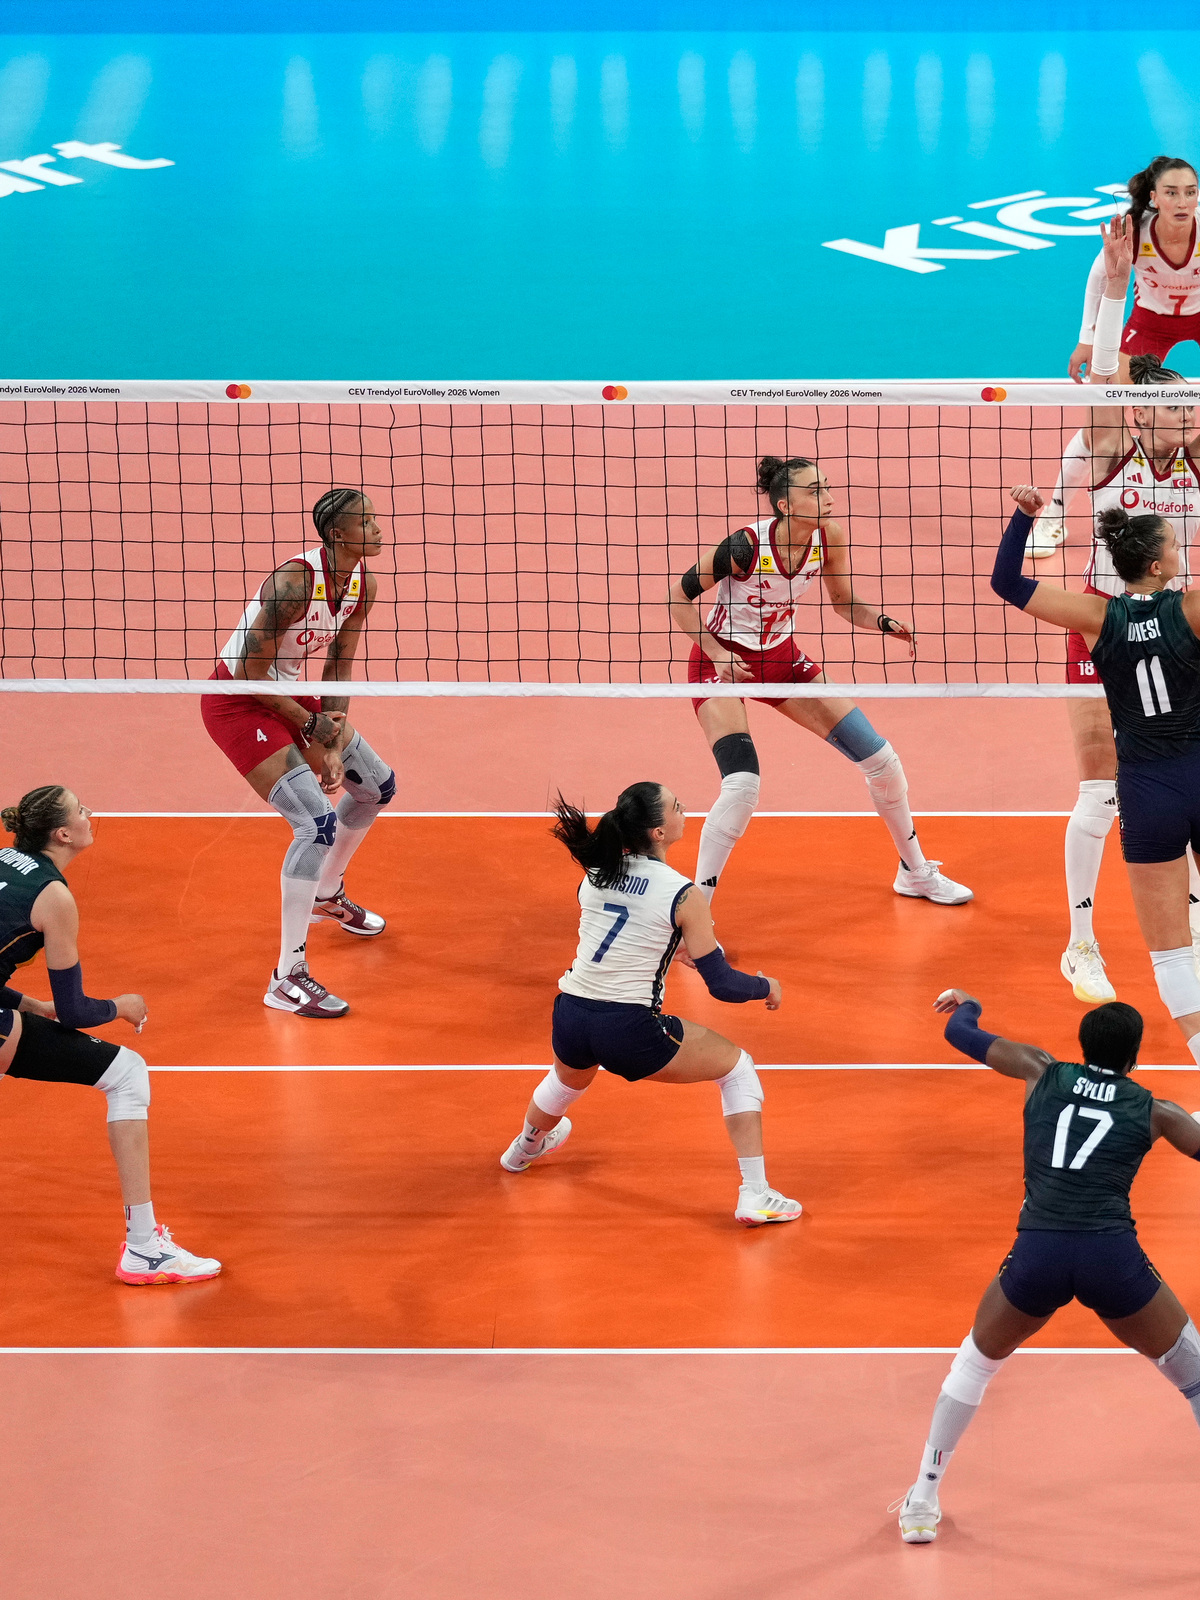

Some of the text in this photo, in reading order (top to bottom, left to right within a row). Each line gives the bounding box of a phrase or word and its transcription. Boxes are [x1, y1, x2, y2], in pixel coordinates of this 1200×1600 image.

[1169, 294, 1188, 315] 7
[1125, 329, 1137, 343] 7
[24, 385, 66, 395] EuroVolley
[68, 385, 88, 394] 2026
[89, 386, 121, 394] Women
[349, 388, 500, 397] CEV Trendyol EuroVolley 2026 Women
[730, 389, 883, 399] CEV Trendyol EuroVolley 2026 Women
[1105, 390, 1123, 398] CEV
[1124, 390, 1159, 400] Trendyol
[1142, 499, 1194, 513] vodafone
[1077, 660, 1095, 676] 18
[1136, 655, 1172, 717] 11
[256, 728, 268, 743] 4
[590, 902, 630, 963] 7
[1072, 1076, 1117, 1102] SYLLA
[1051, 1103, 1114, 1170] 17
